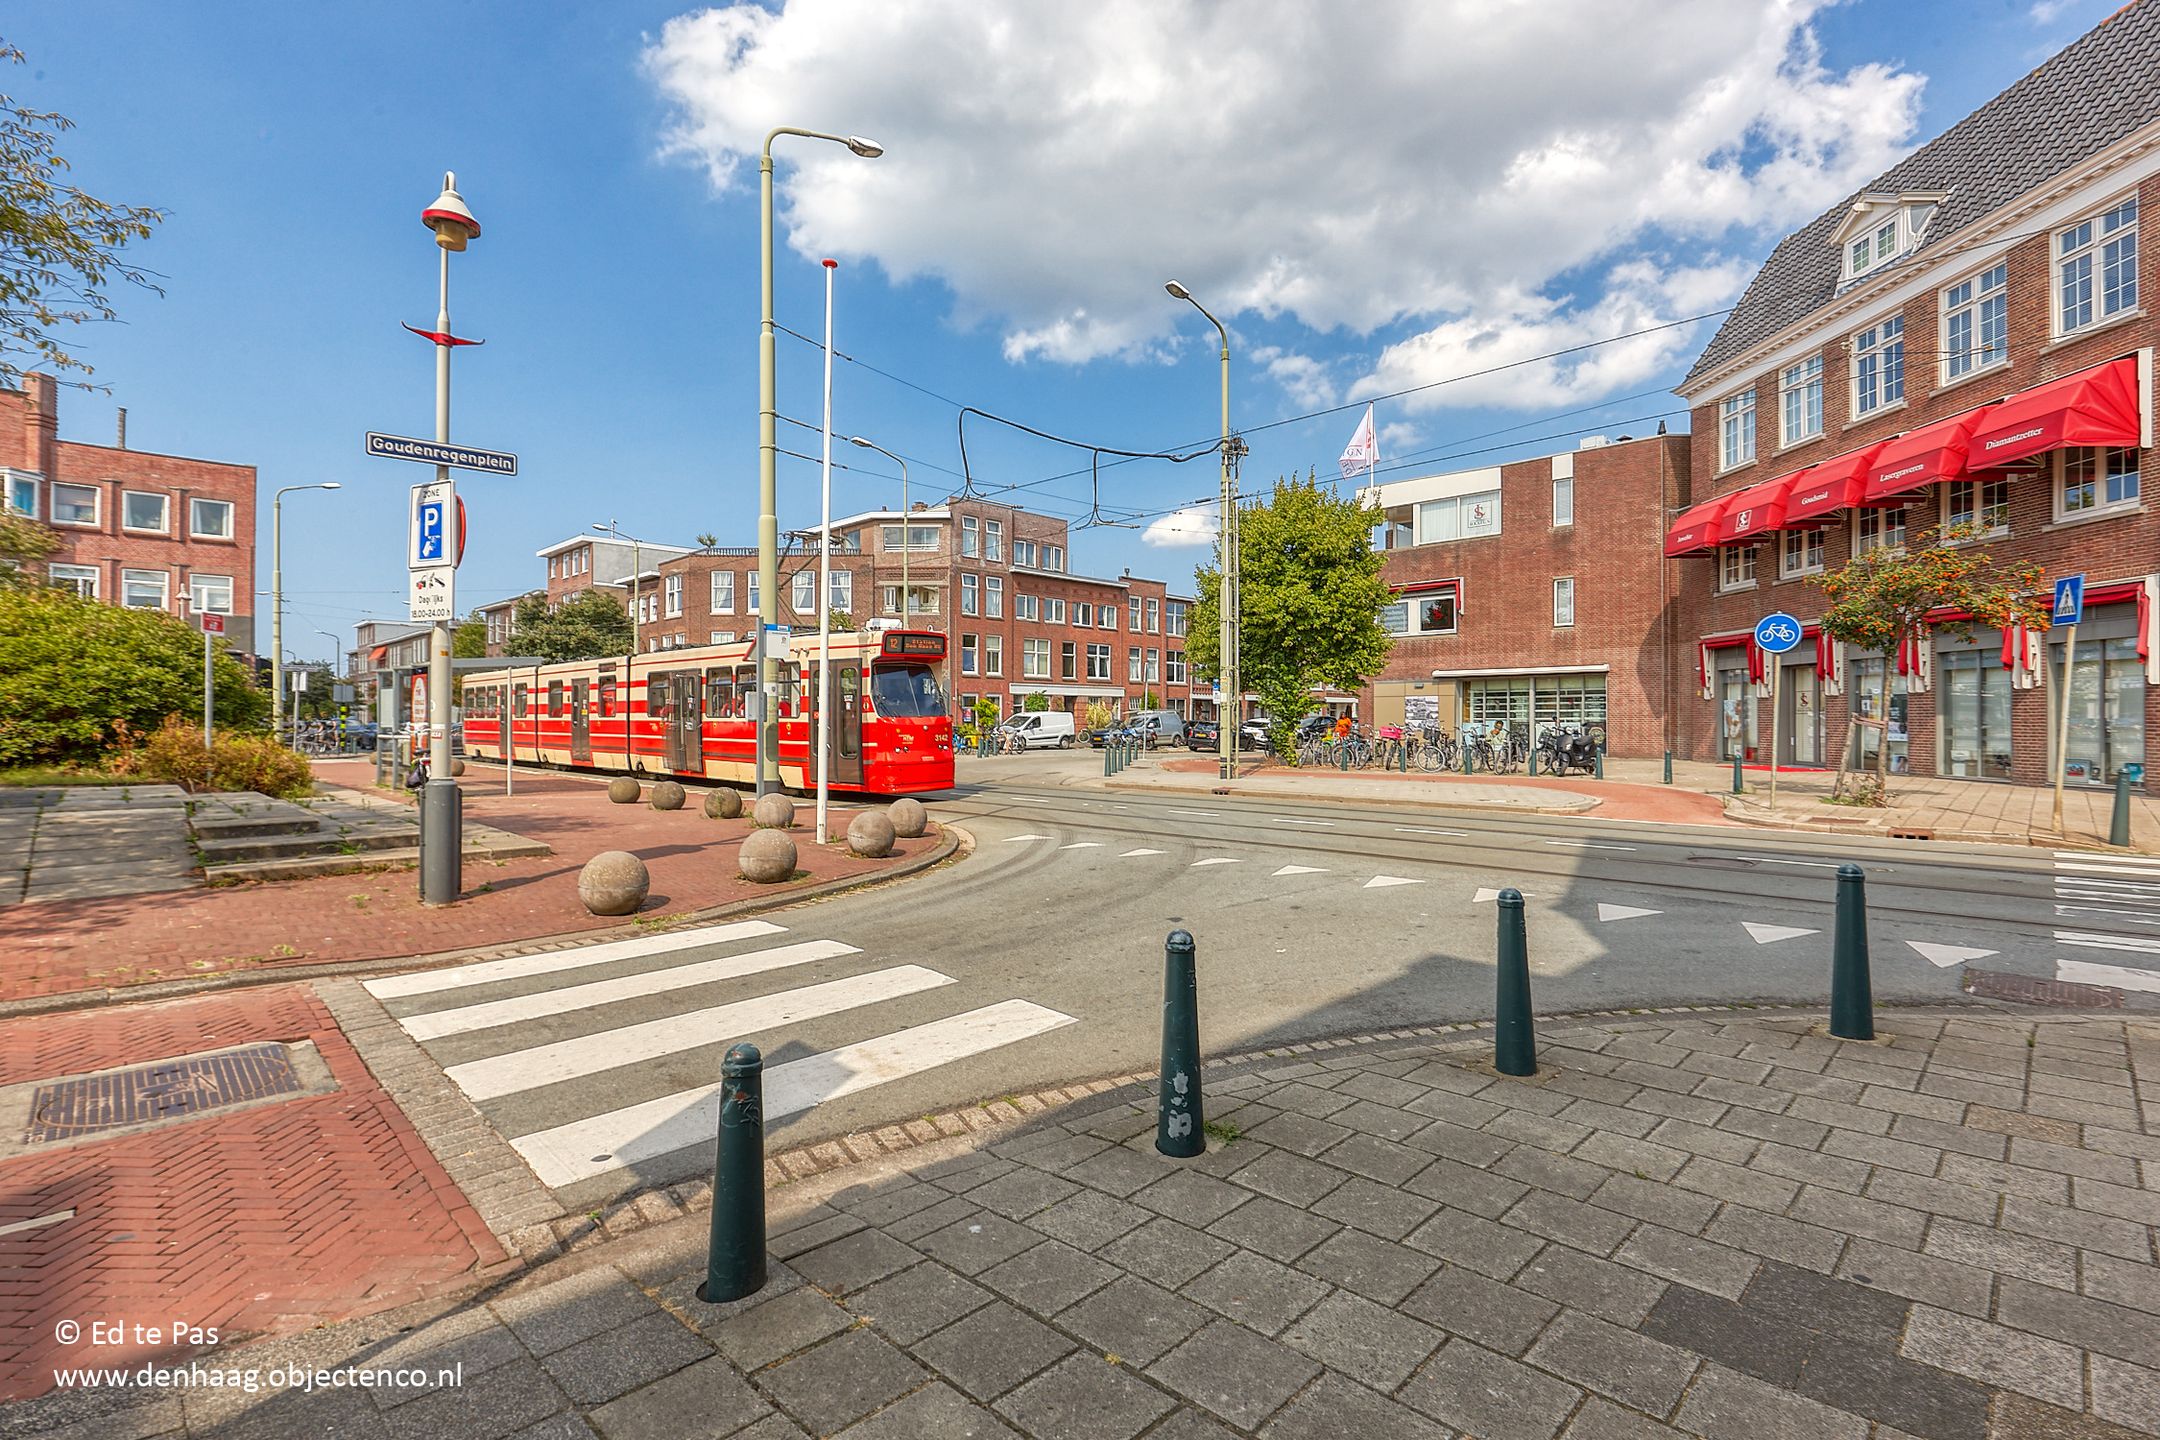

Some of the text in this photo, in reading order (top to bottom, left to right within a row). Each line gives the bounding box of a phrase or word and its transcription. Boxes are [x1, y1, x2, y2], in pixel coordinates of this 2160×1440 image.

[1985, 427, 2044, 450] Diamantzetter
[372, 437, 512, 470] Goudenregenplein
[1880, 464, 1924, 482] Lasergraveren
[423, 489, 439, 498] ZONE
[424, 507, 439, 537] P
[935, 734, 948, 742] 3142
